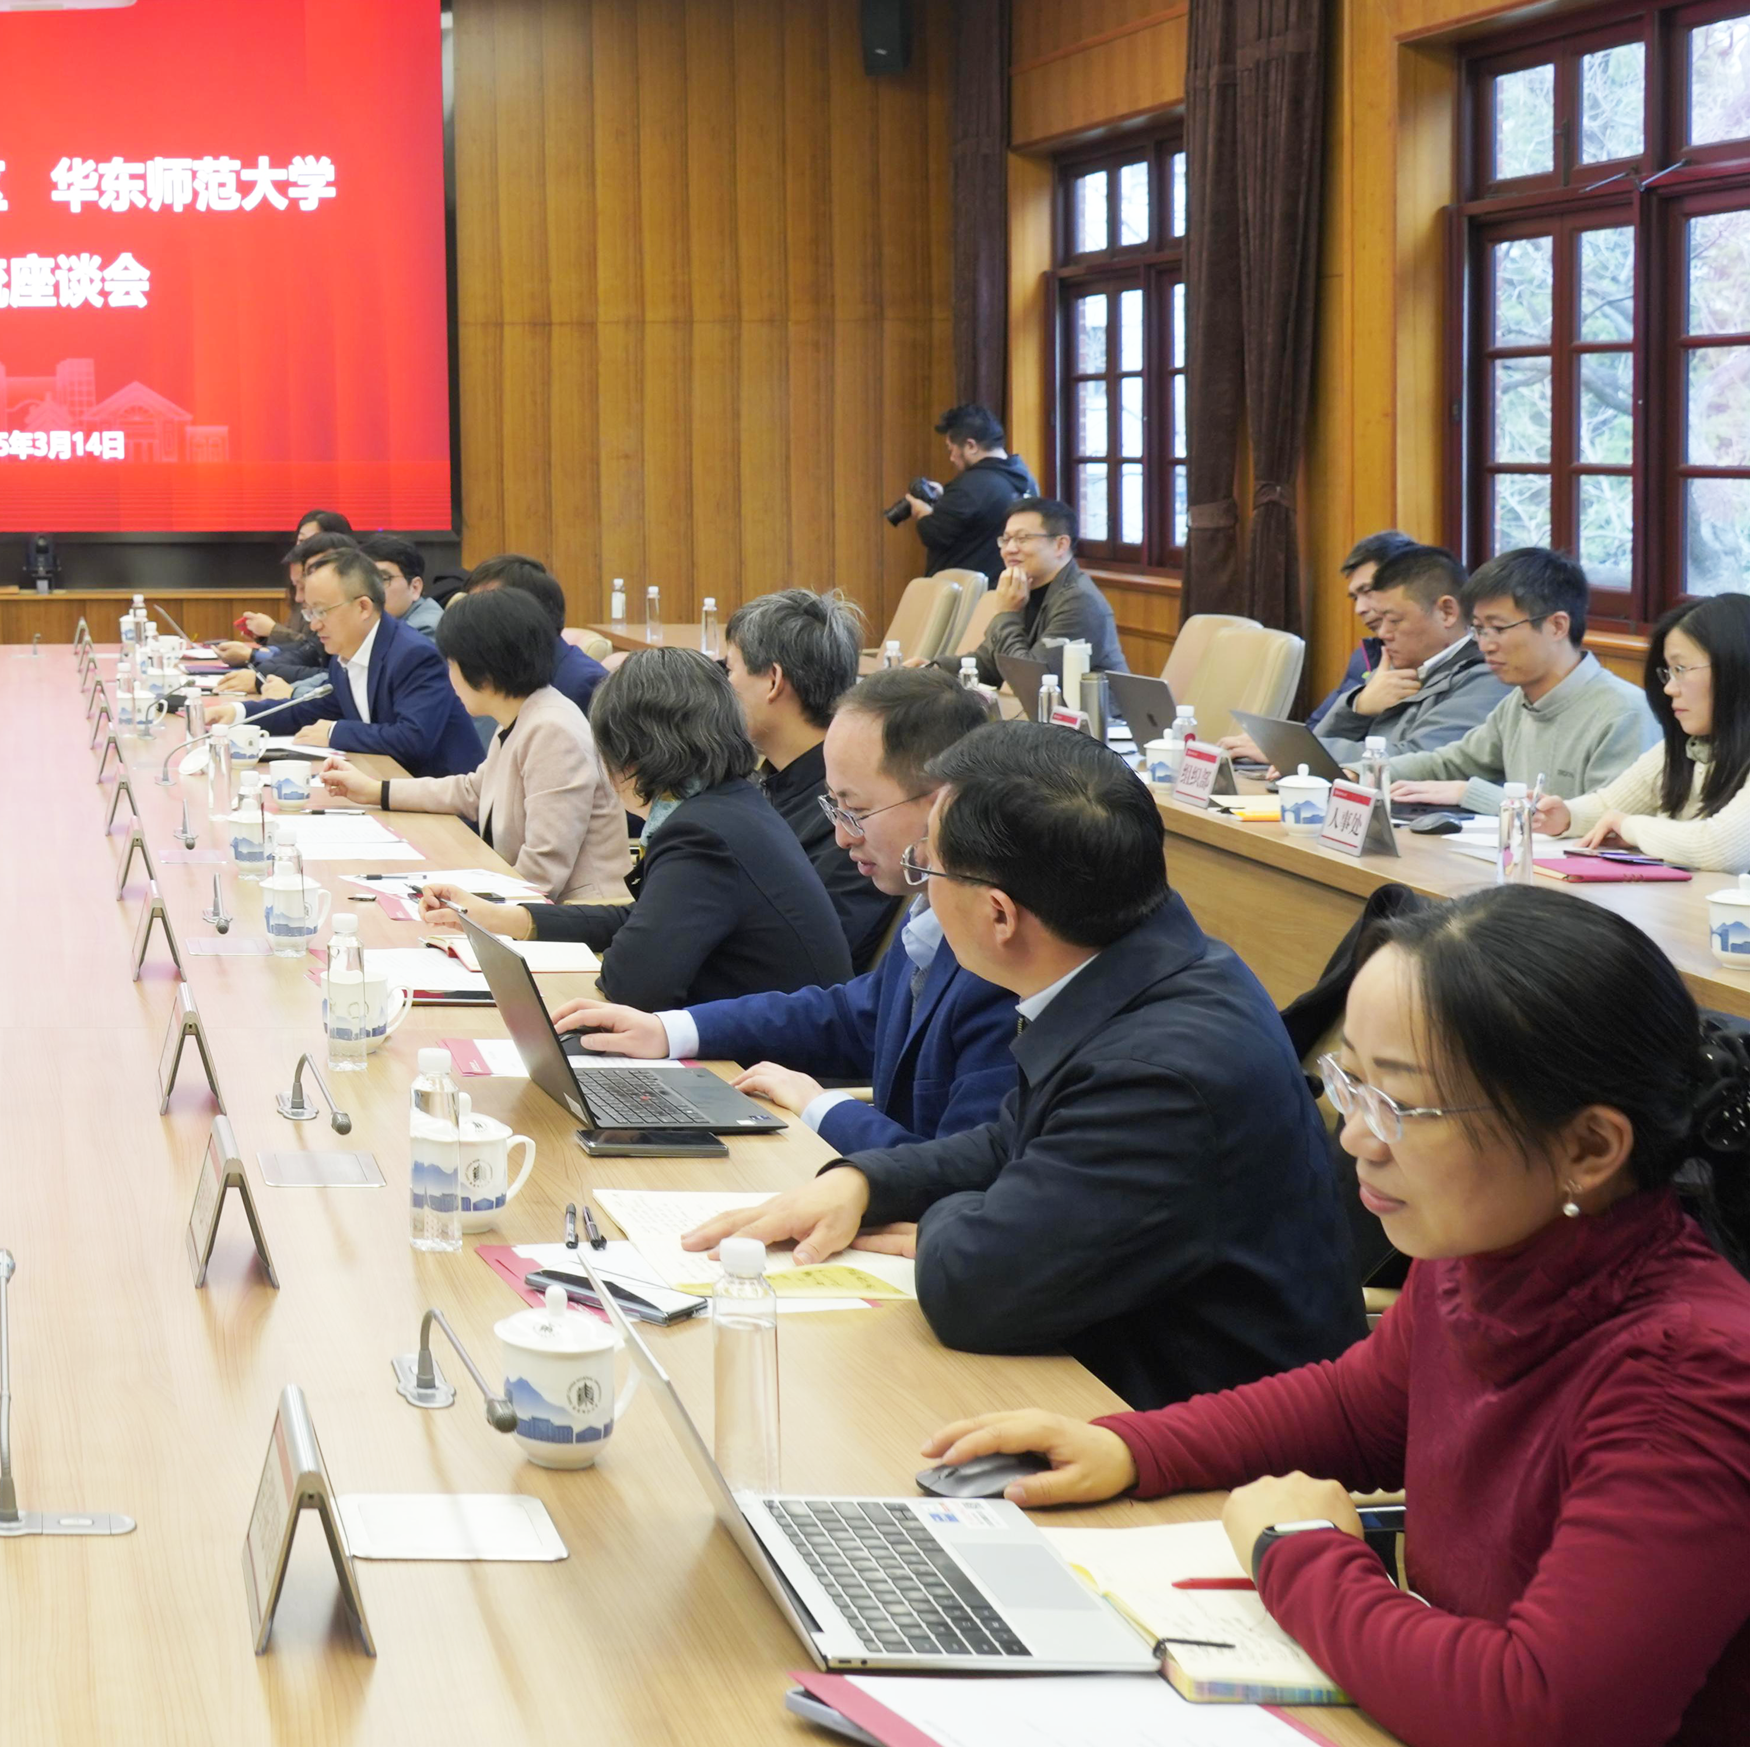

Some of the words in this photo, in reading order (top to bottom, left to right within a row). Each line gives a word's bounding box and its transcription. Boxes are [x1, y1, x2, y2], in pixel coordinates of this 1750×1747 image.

[49, 155, 337, 213] 华东师范大学
[1328, 807, 1362, 836] 人事处
